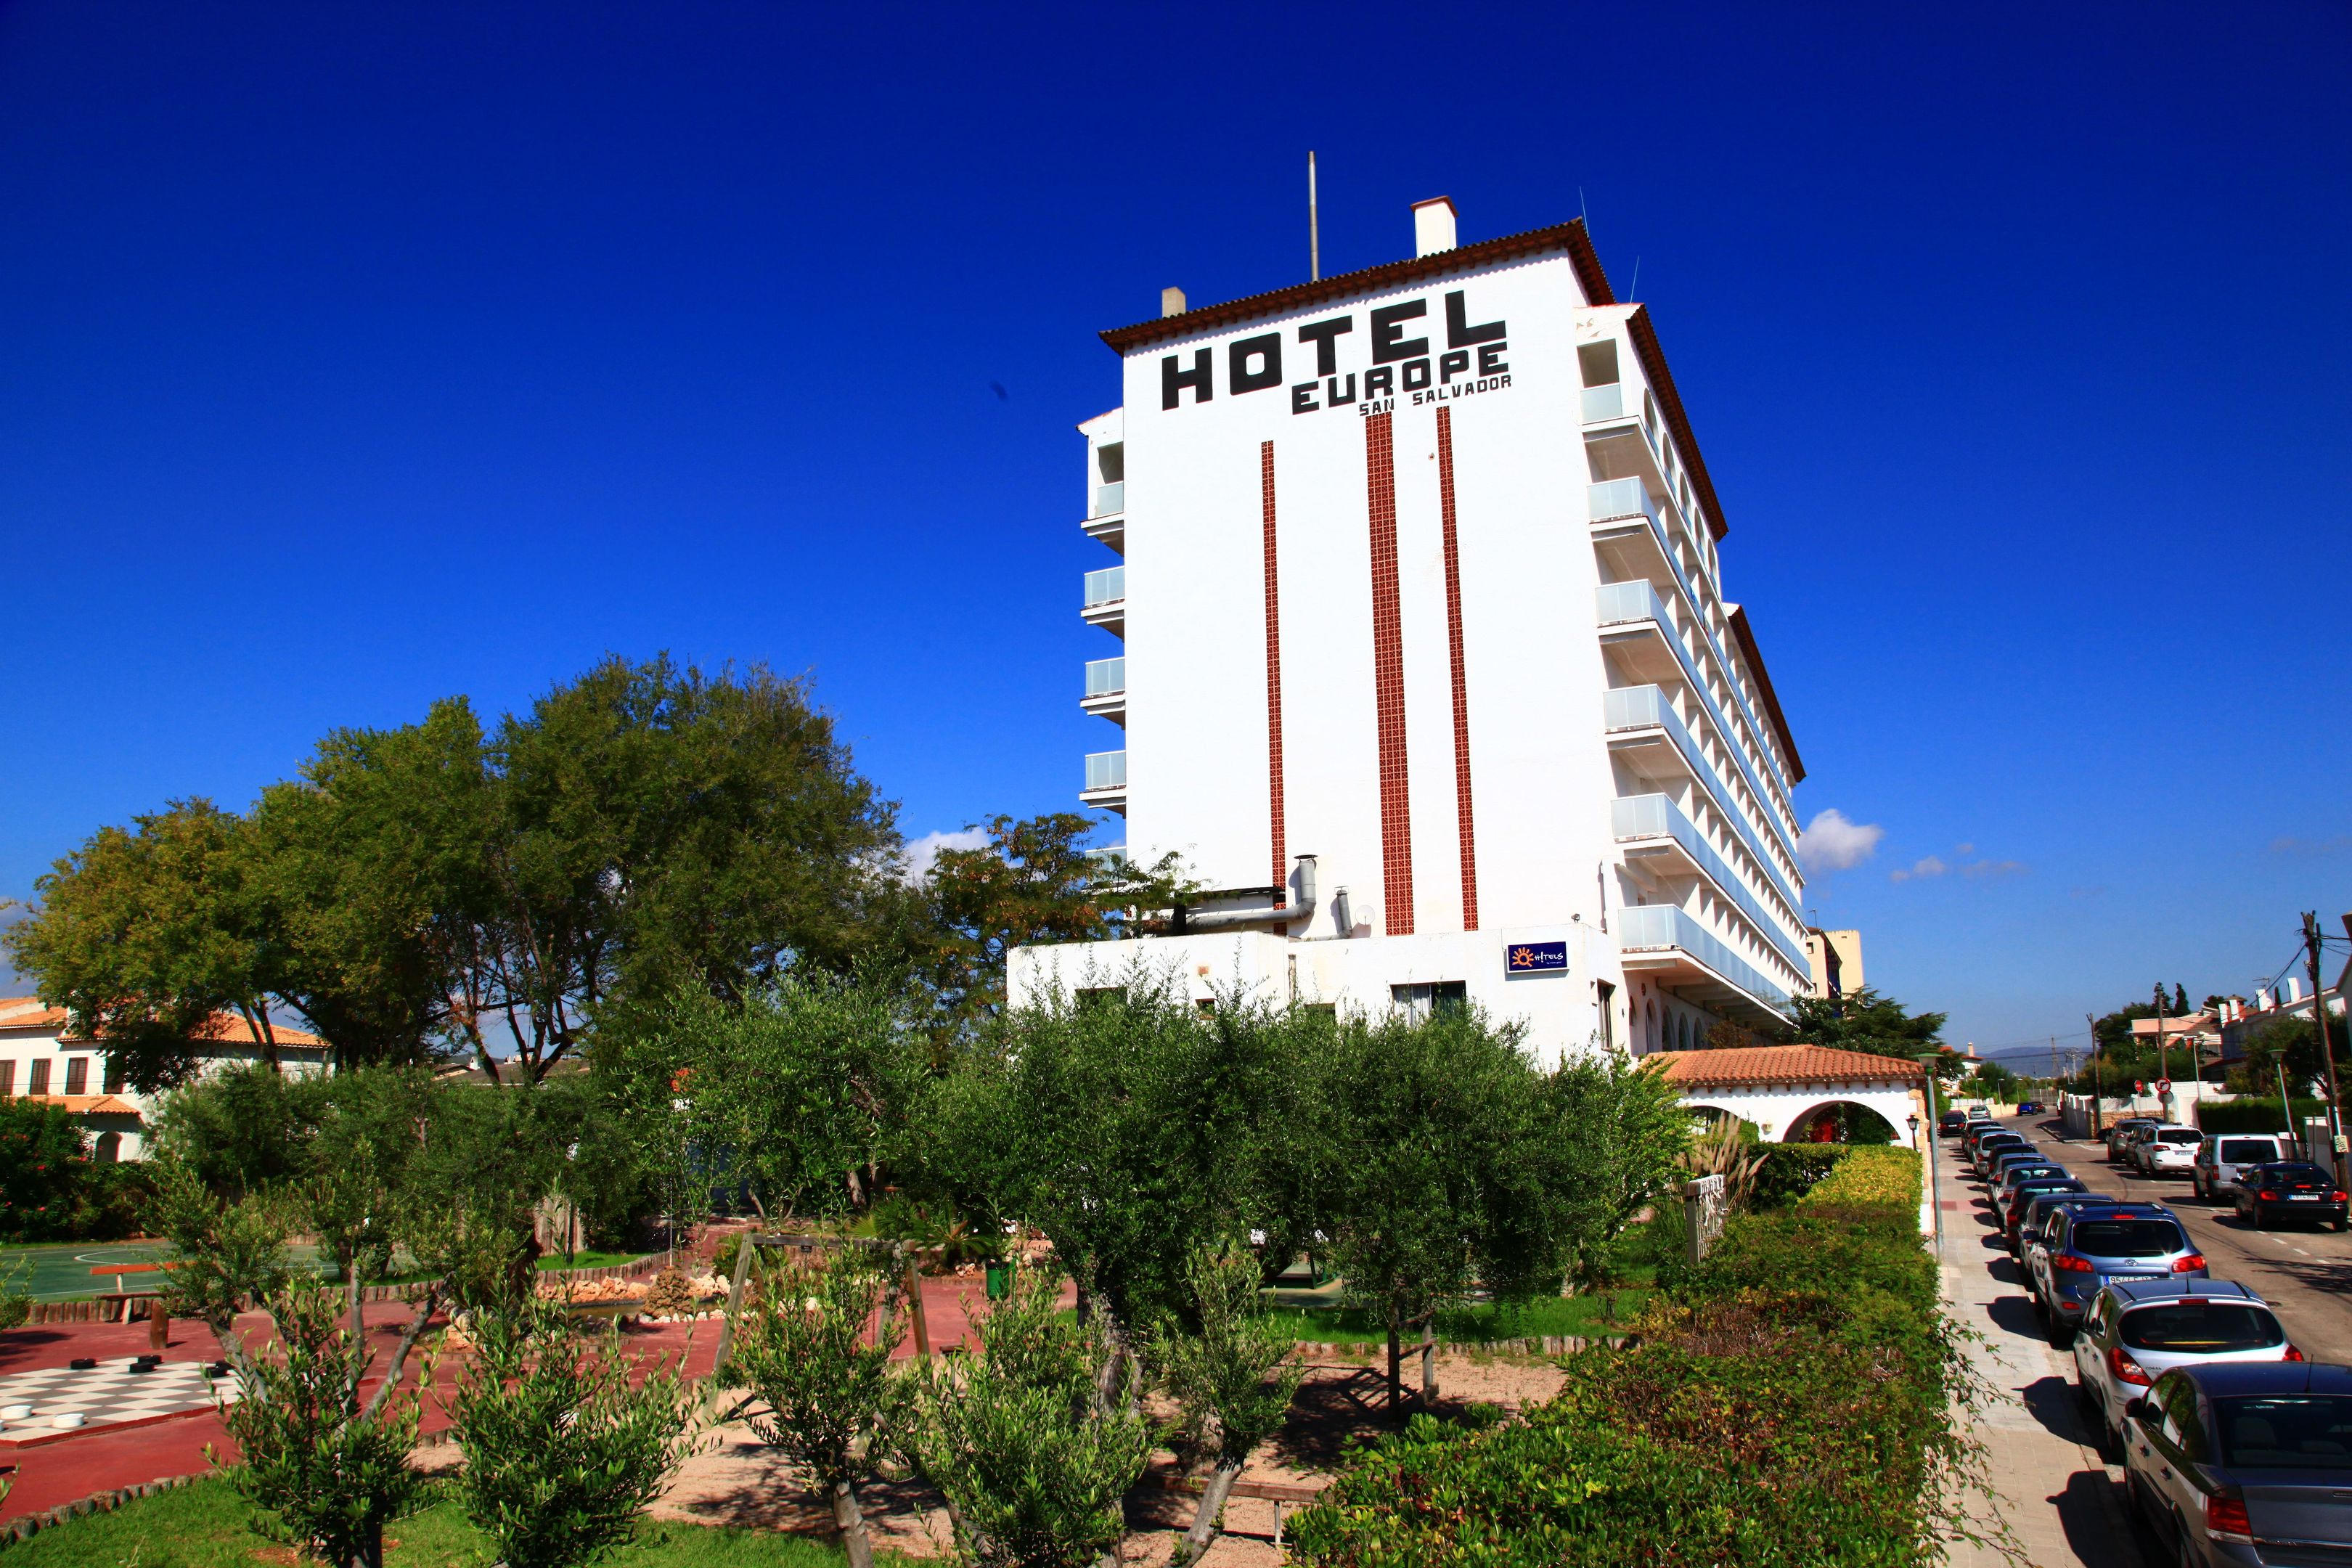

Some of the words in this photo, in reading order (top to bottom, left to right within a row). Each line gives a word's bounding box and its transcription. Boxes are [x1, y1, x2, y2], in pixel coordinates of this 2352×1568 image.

[1161, 290, 1506, 412] HOTEL
[1291, 341, 1509, 415] EUROPE
[1359, 399, 1395, 416] SAN
[1413, 375, 1511, 406] SALVADOR
